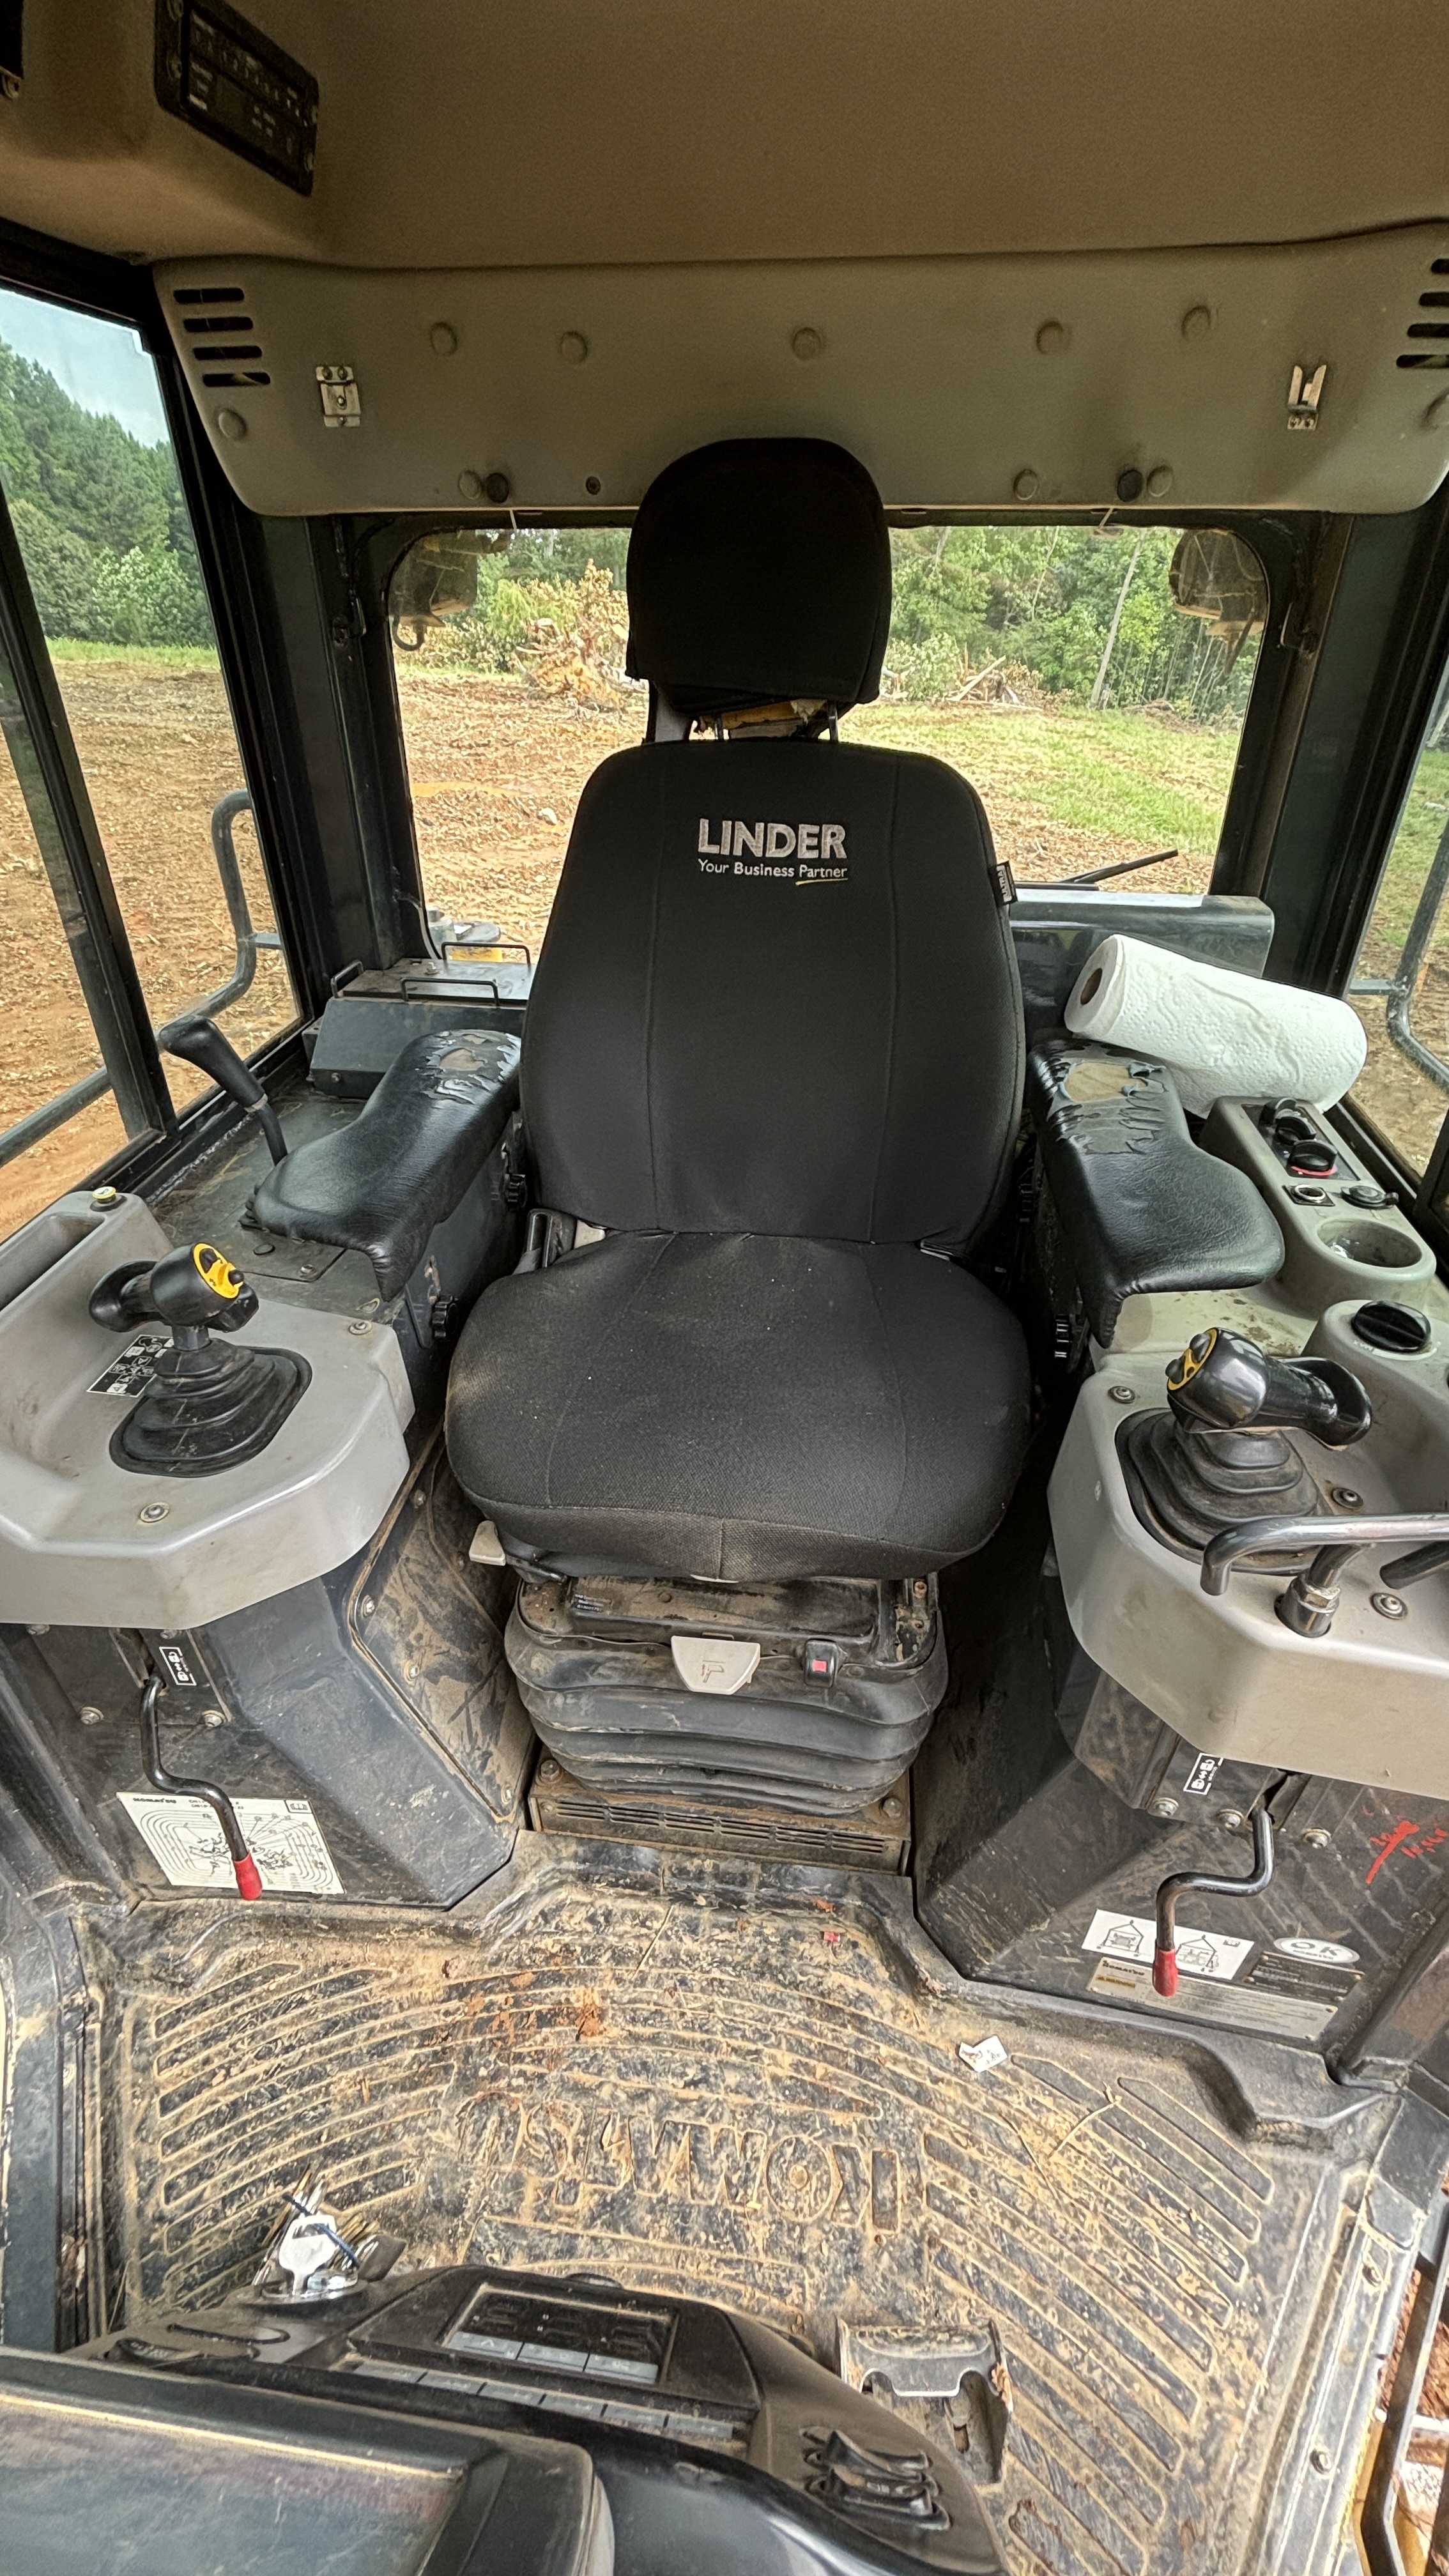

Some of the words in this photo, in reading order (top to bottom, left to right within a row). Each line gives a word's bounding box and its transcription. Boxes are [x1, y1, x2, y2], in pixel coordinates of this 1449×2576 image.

[698, 818, 847, 859] LINDER
[698, 858, 730, 874] Your
[733, 862, 795, 878] Business
[799, 864, 848, 878] Partner
[997, 867, 1011, 899] ULTRA
[1291, 1942, 1342, 1956] OK
